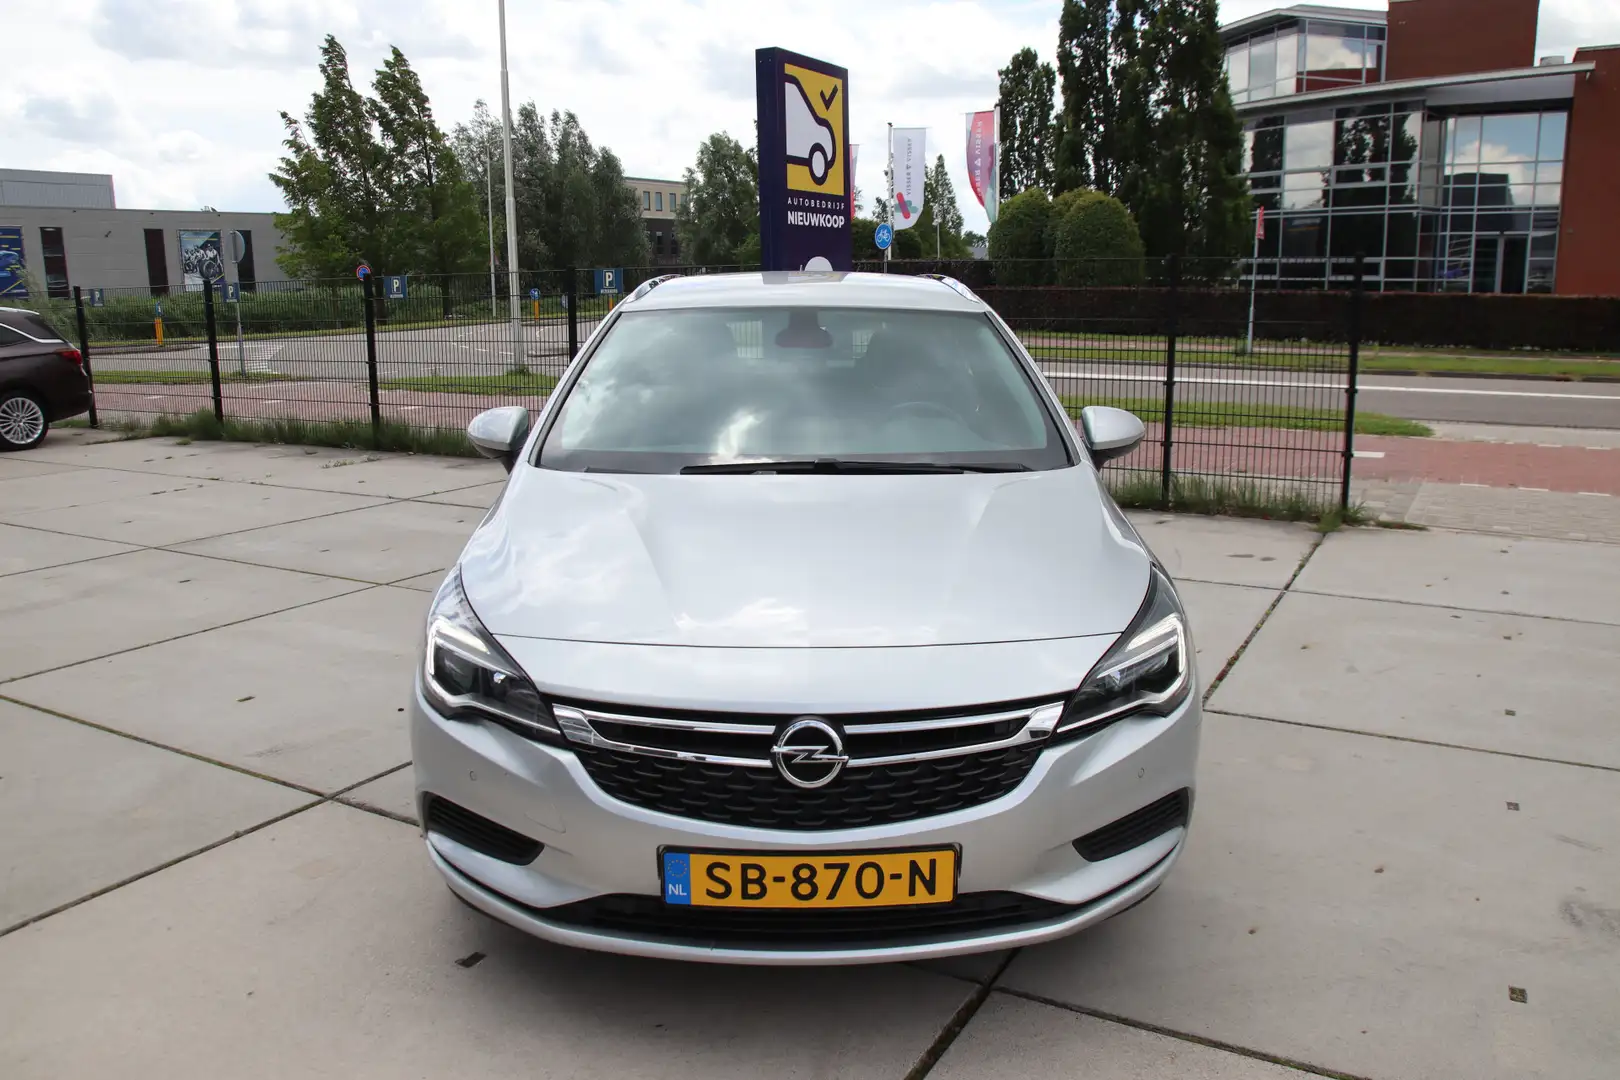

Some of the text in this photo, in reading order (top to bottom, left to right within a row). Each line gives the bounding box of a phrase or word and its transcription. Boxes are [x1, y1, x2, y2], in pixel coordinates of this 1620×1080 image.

[787, 196, 845, 210] AUTOBEDRIJF
[787, 210, 845, 228] NIEUWKOOP
[393, 279, 400, 292] P
[605, 271, 613, 287] P
[228, 285, 234, 298] P
[705, 858, 937, 901] SB-870-N
[668, 883, 687, 896] NL
